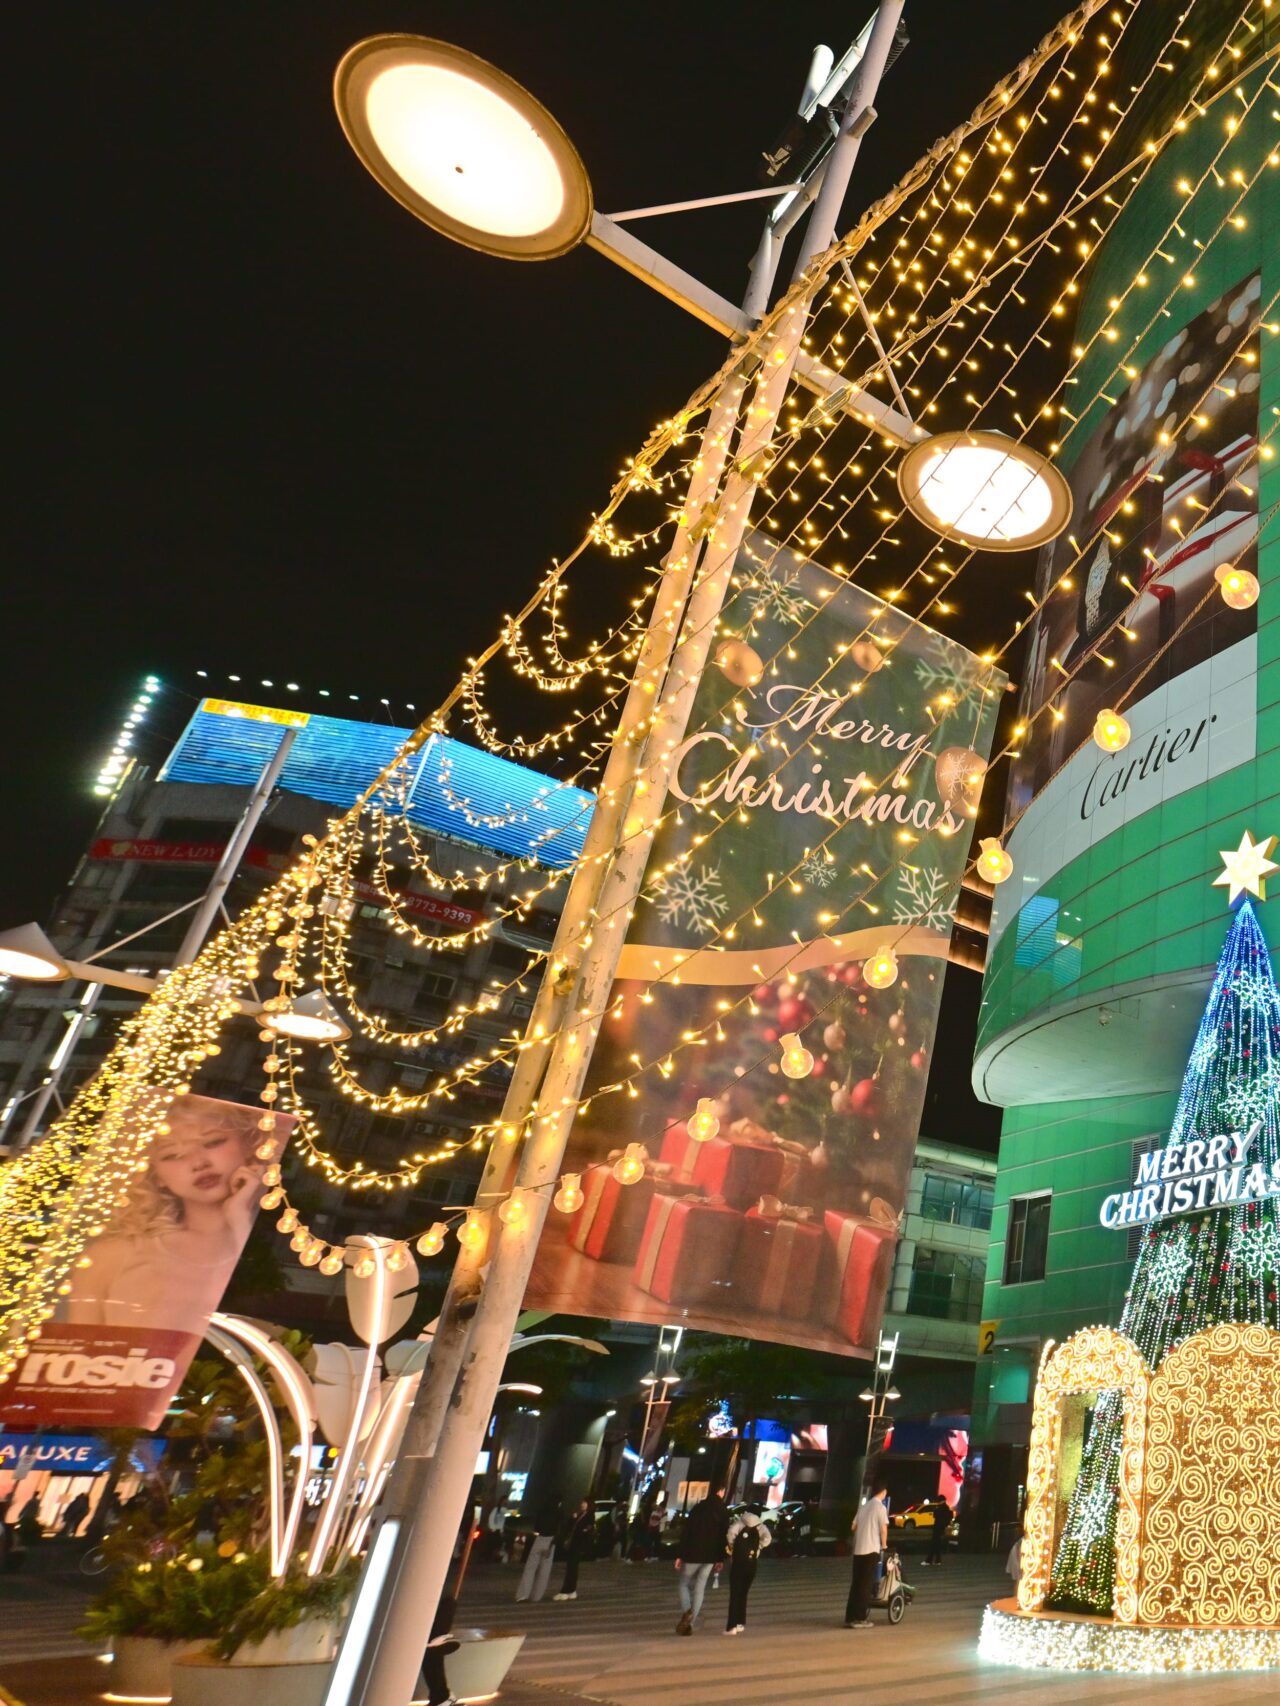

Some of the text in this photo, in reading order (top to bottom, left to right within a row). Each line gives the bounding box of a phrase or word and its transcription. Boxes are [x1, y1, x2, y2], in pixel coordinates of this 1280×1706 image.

[735, 684, 931, 789] Merry
[1080, 714, 1218, 820] Cartier
[668, 730, 965, 834] Christmas
[130, 845, 221, 859] NEW LADY
[1134, 1119, 1263, 1186] MERRY
[18, 1348, 175, 1389] rosie
[984, 1330, 995, 1355] 2
